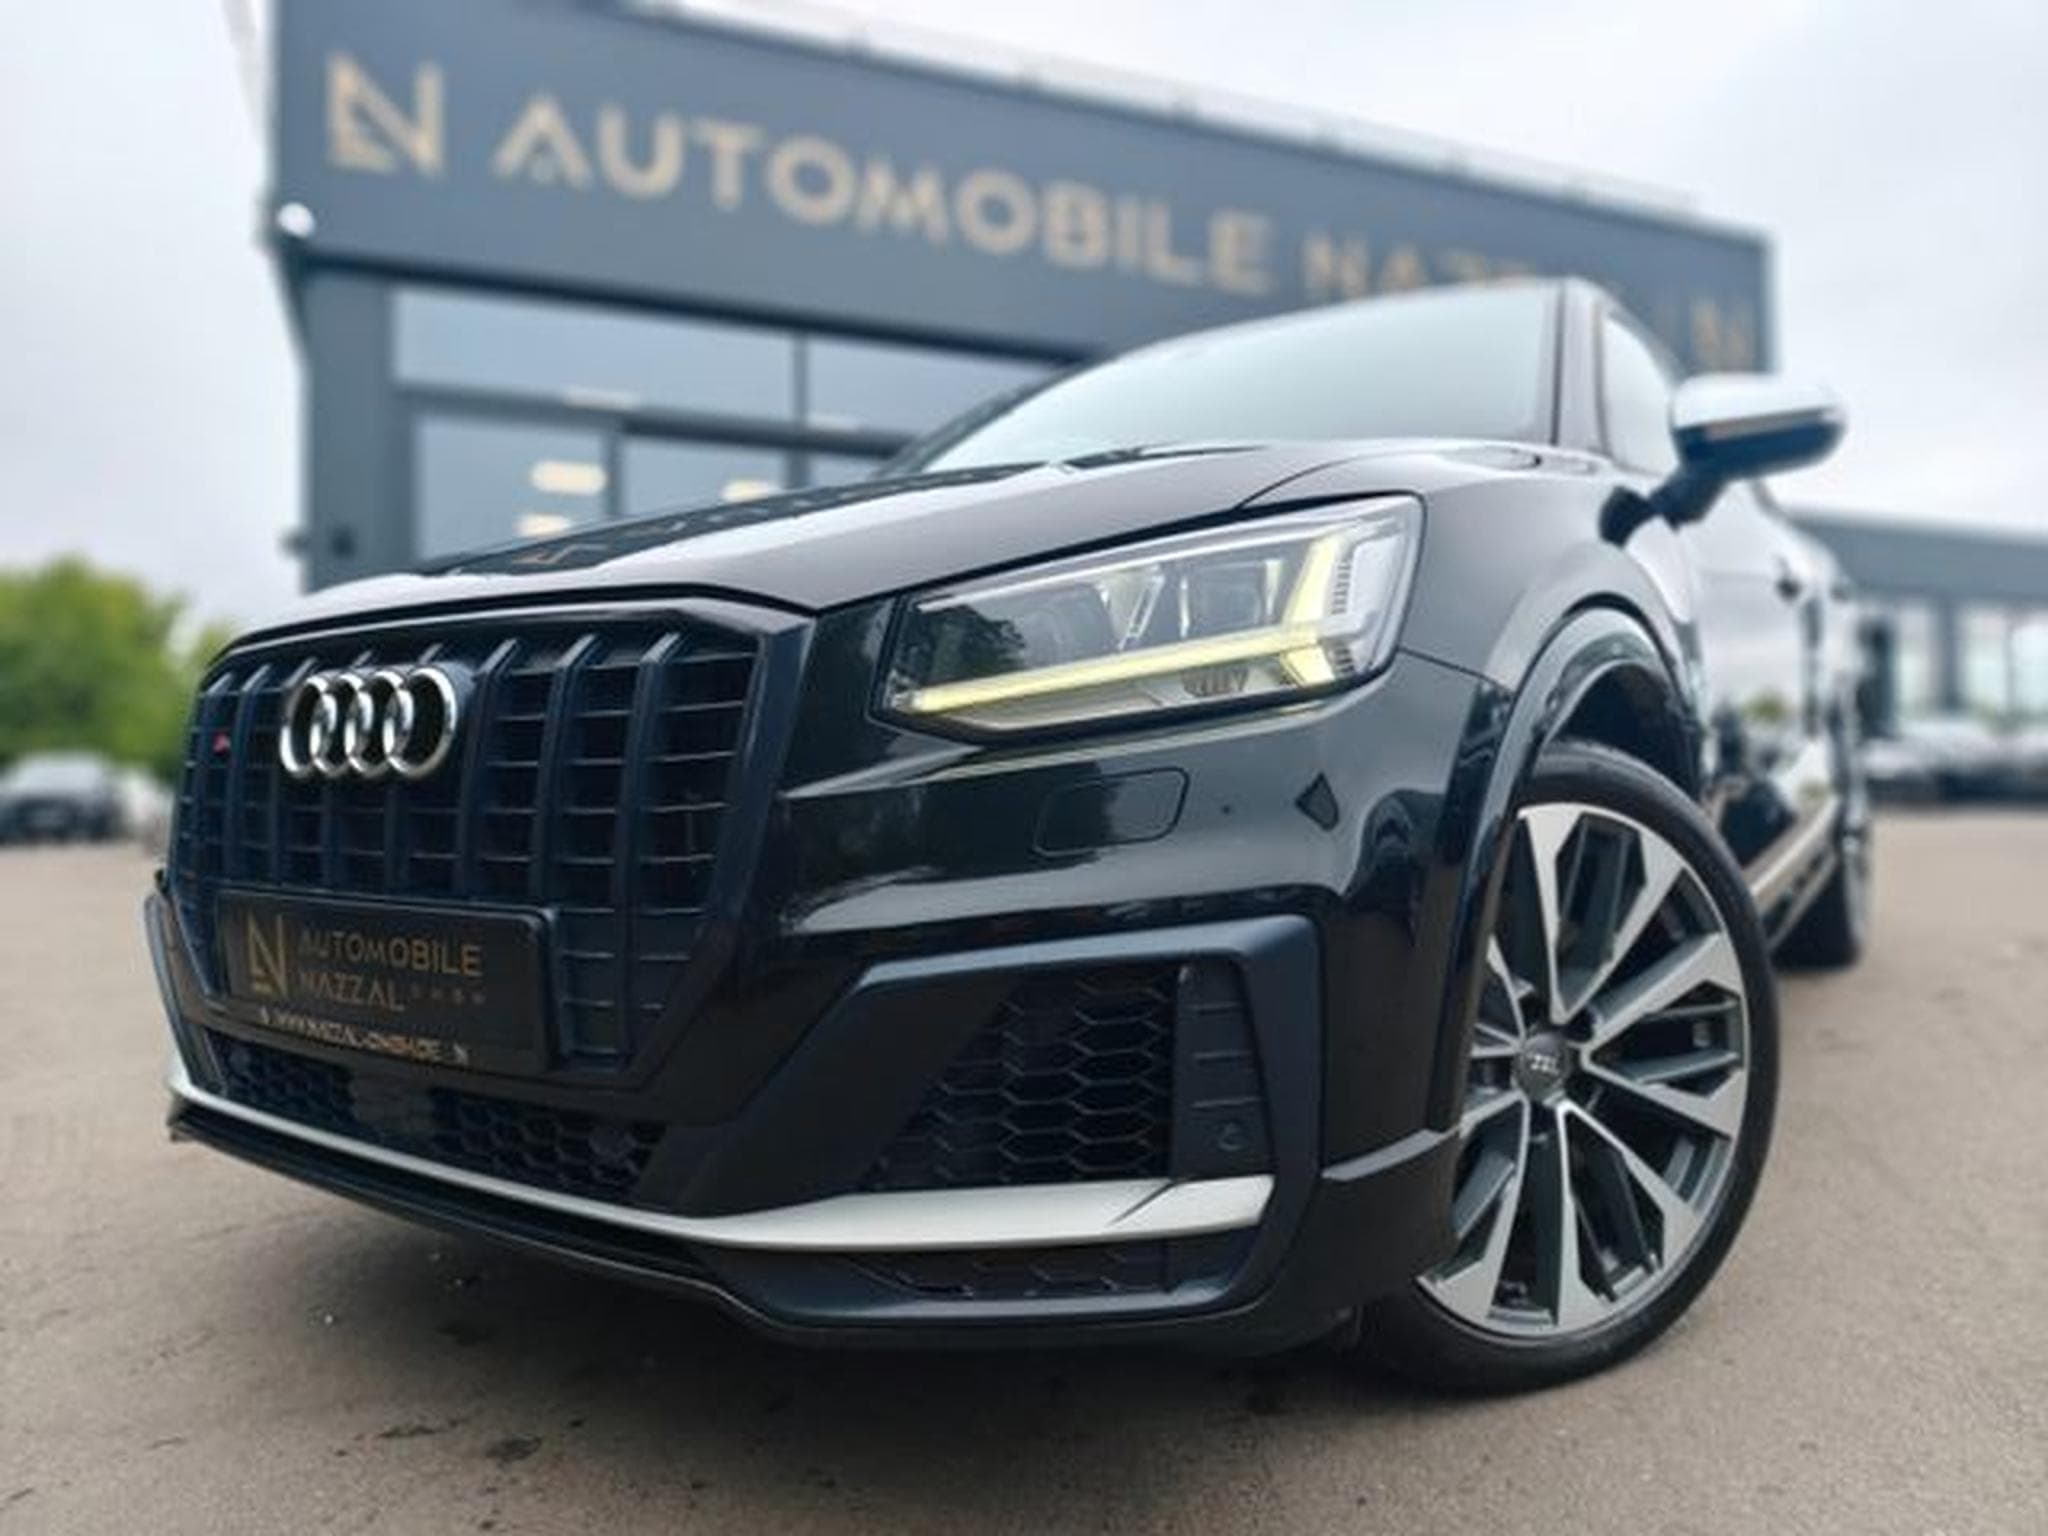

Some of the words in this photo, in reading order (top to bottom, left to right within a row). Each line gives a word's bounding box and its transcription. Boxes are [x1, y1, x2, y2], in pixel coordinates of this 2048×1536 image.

[494, 94, 1272, 295] AUTOMOBILE
[300, 928, 484, 977] AUTOMOBILE
[300, 969, 405, 1012] NAZZAL
